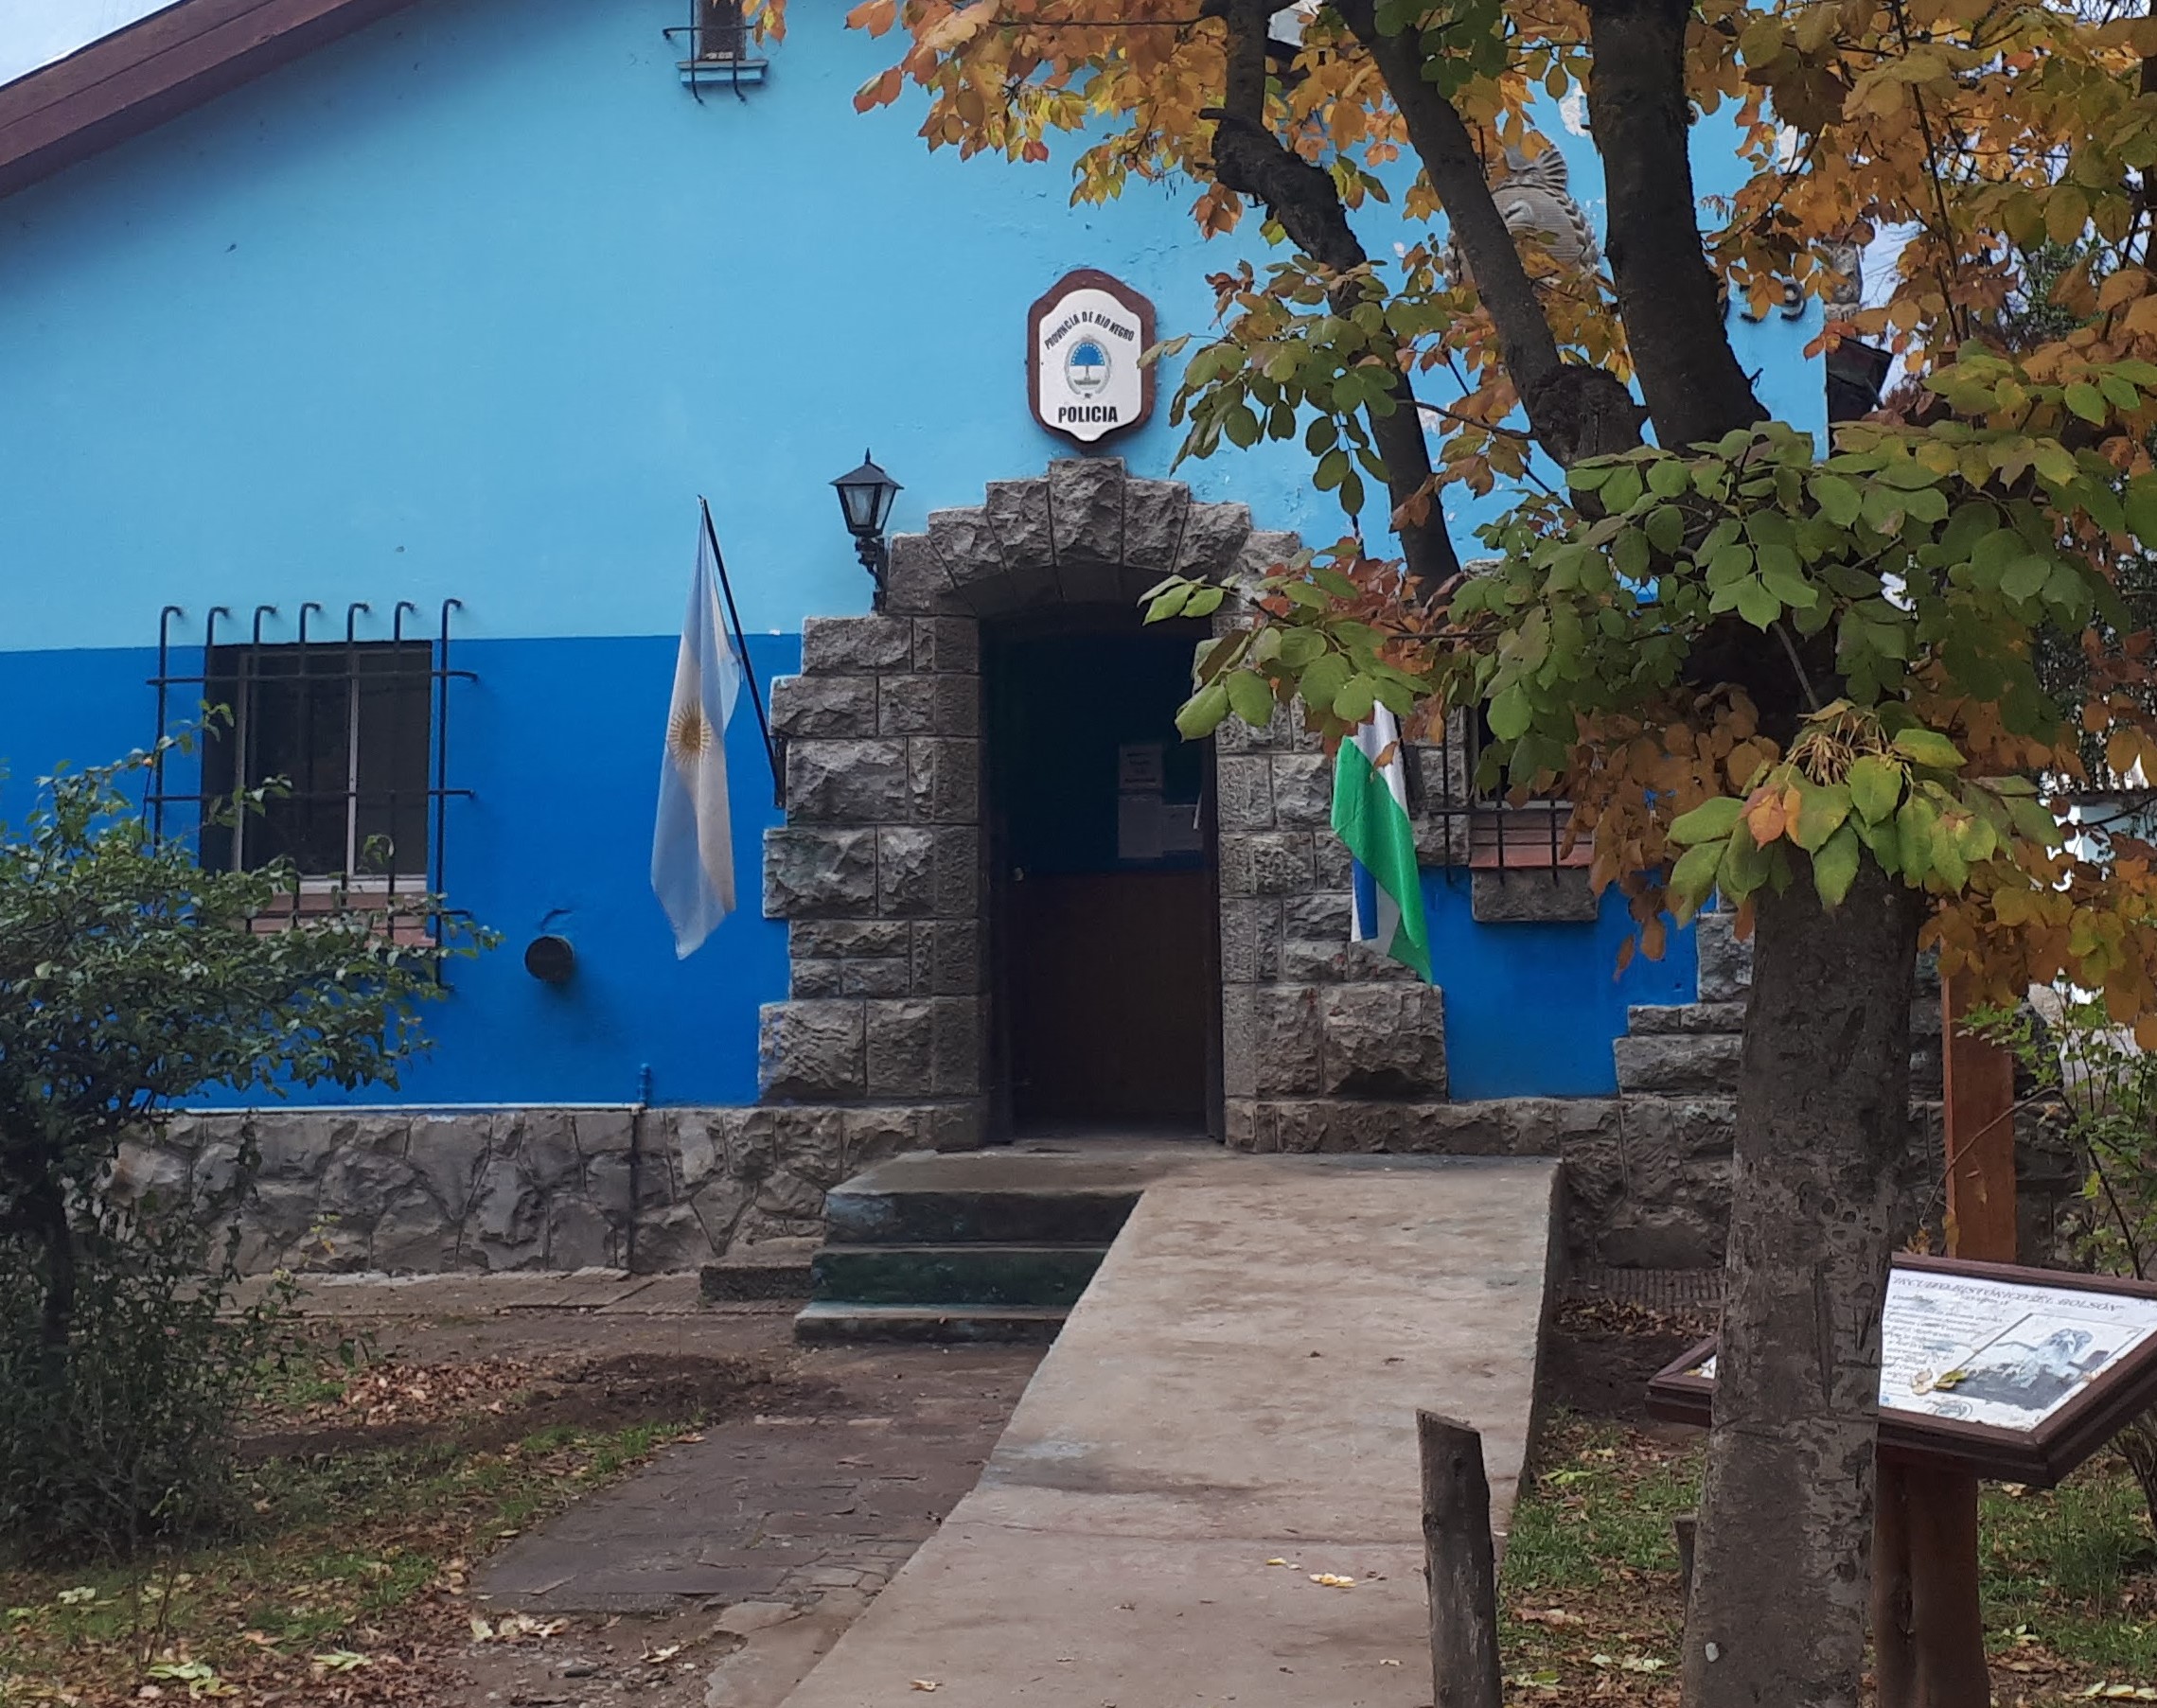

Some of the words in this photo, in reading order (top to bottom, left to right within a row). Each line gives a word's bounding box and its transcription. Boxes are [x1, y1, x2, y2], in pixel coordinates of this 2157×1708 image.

[1044, 313, 1080, 350] PROVINCIA
[1082, 311, 1093, 323] DE
[1108, 323, 1135, 343] NEGRO
[1058, 406, 1118, 423] POLICIA
